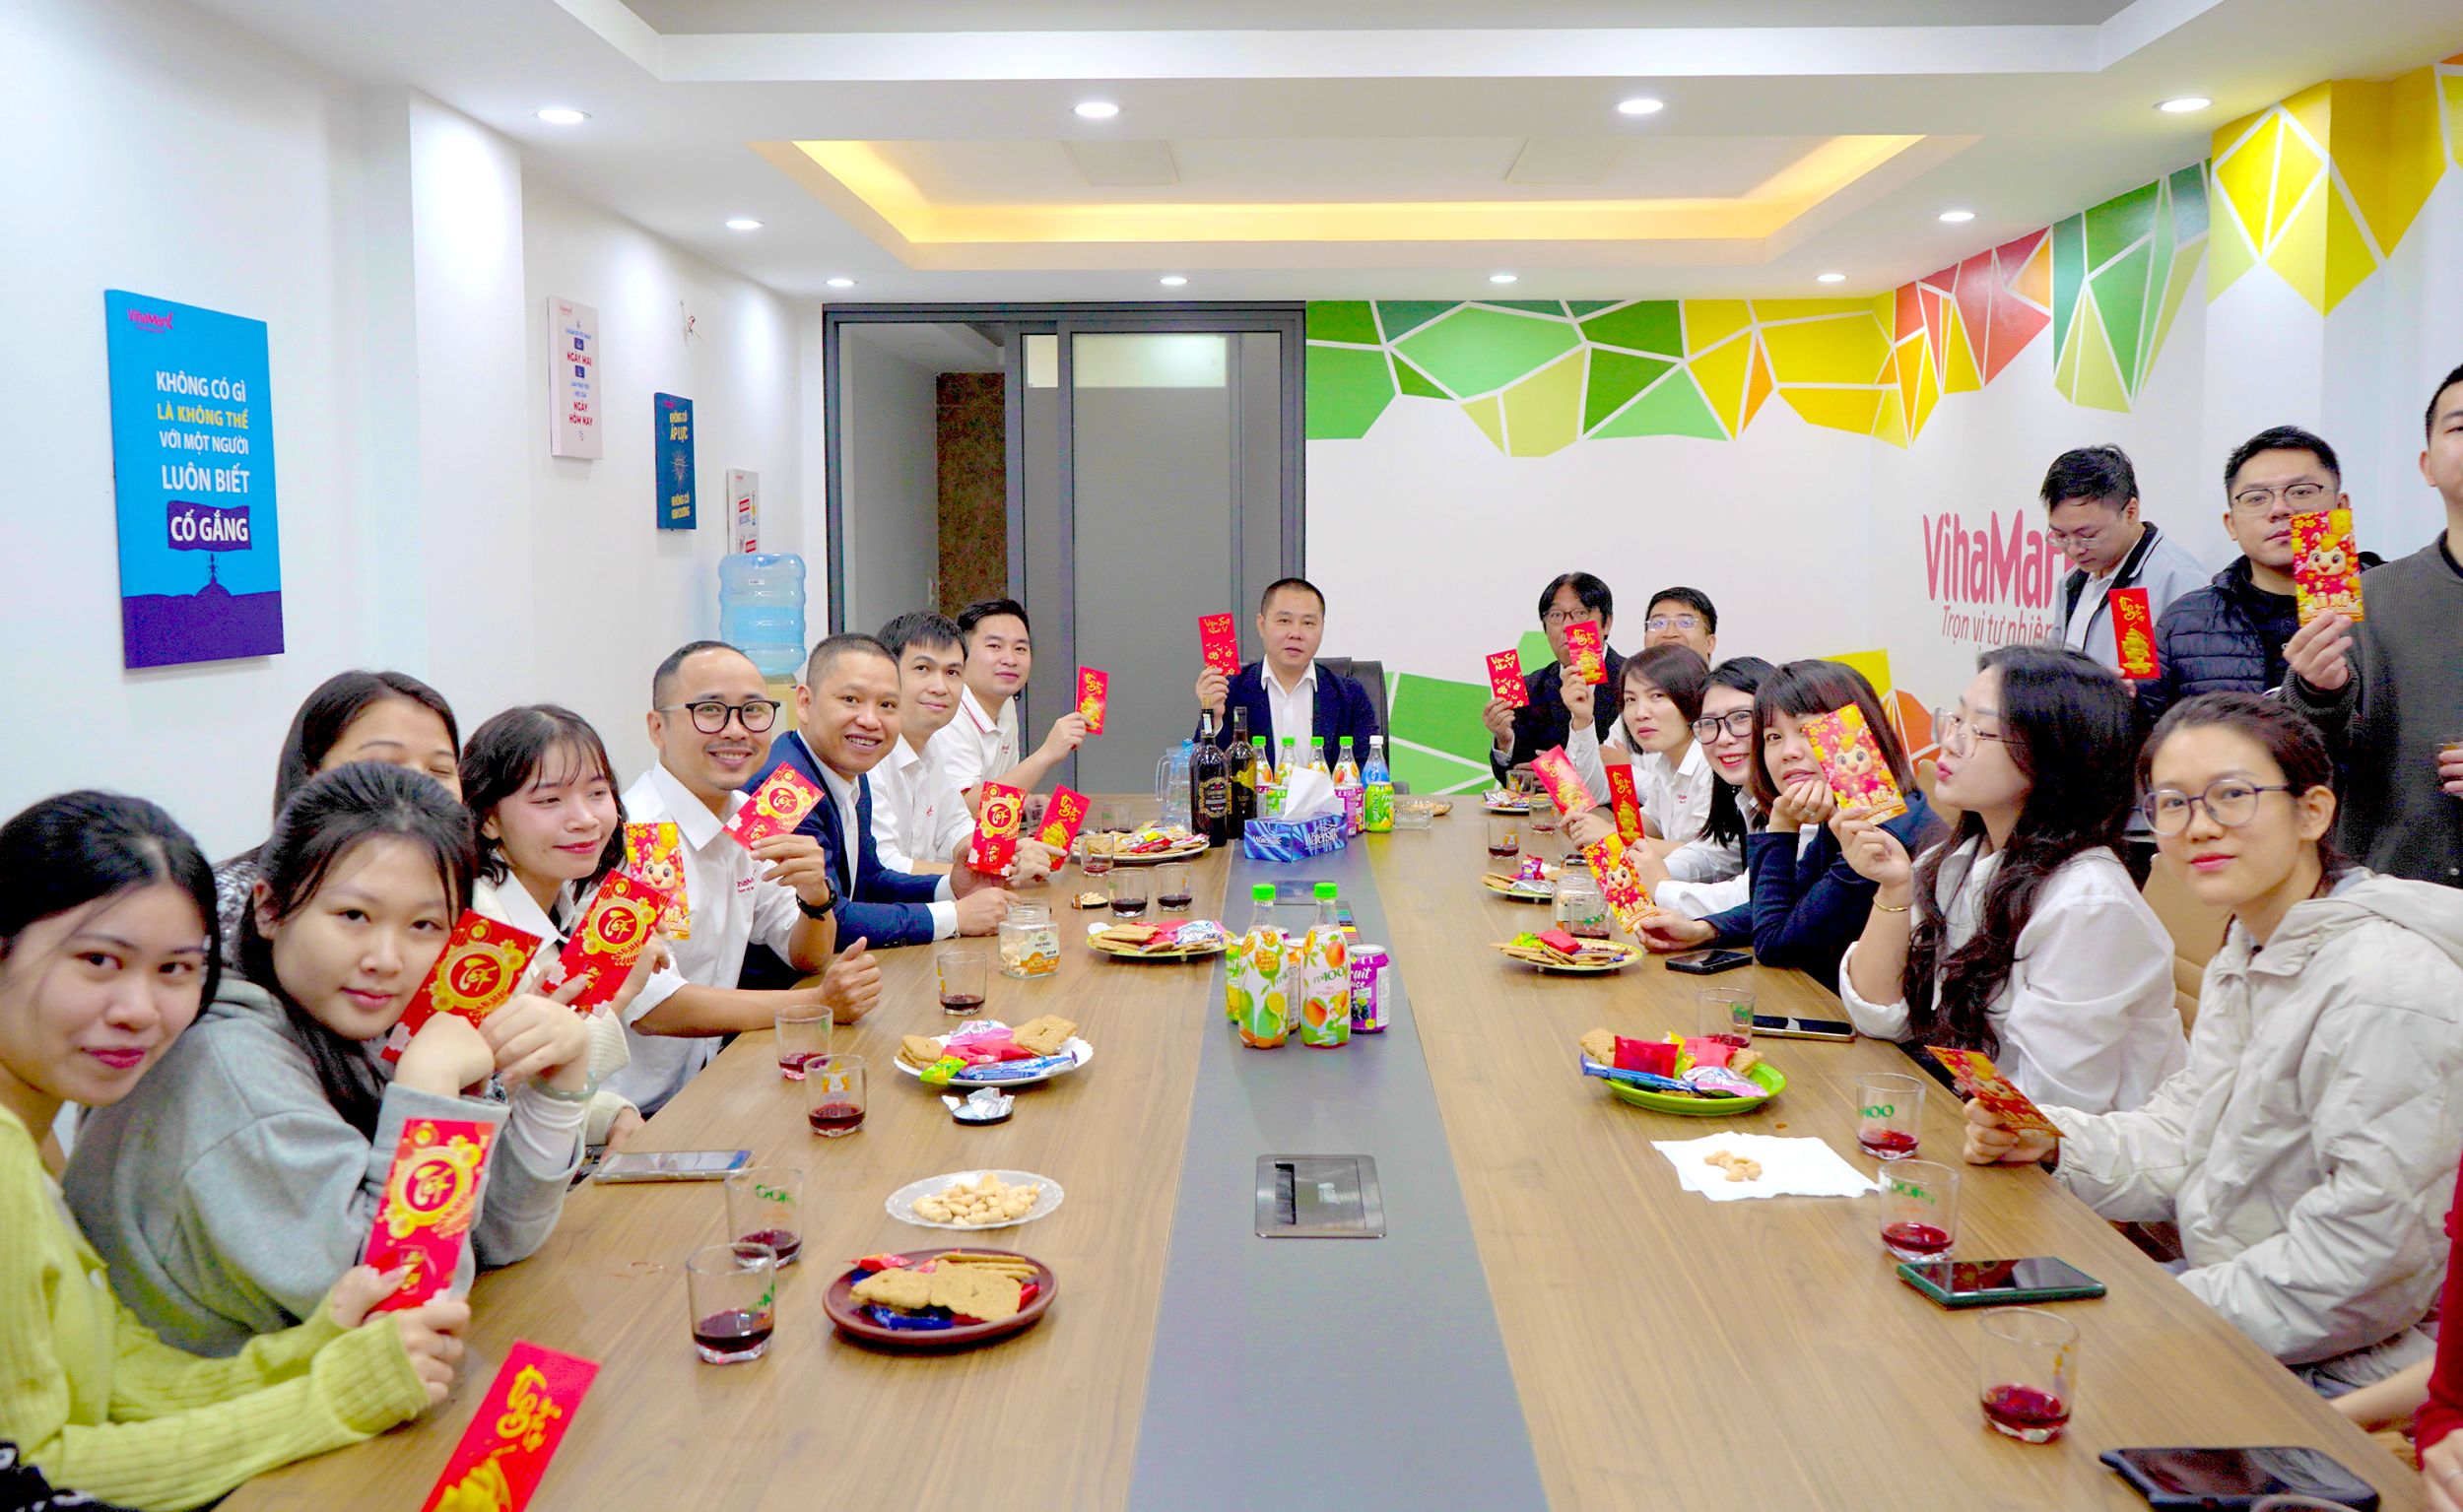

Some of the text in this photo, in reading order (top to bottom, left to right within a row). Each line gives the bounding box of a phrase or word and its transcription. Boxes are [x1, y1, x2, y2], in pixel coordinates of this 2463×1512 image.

[156, 369, 246, 402] KHÔNG CÓ GÌ
[157, 400, 174, 421] LÀ
[177, 404, 224, 427] KHÔNG
[159, 428, 249, 455] VỚI MỘT NGƯỜI
[162, 461, 250, 493] LUÔN BIẾT
[170, 508, 249, 542] CỐ GẮNG
[1923, 508, 2076, 609] VihaMar
[1942, 605, 1969, 644] Trọn
[1972, 610, 1985, 651] vị
